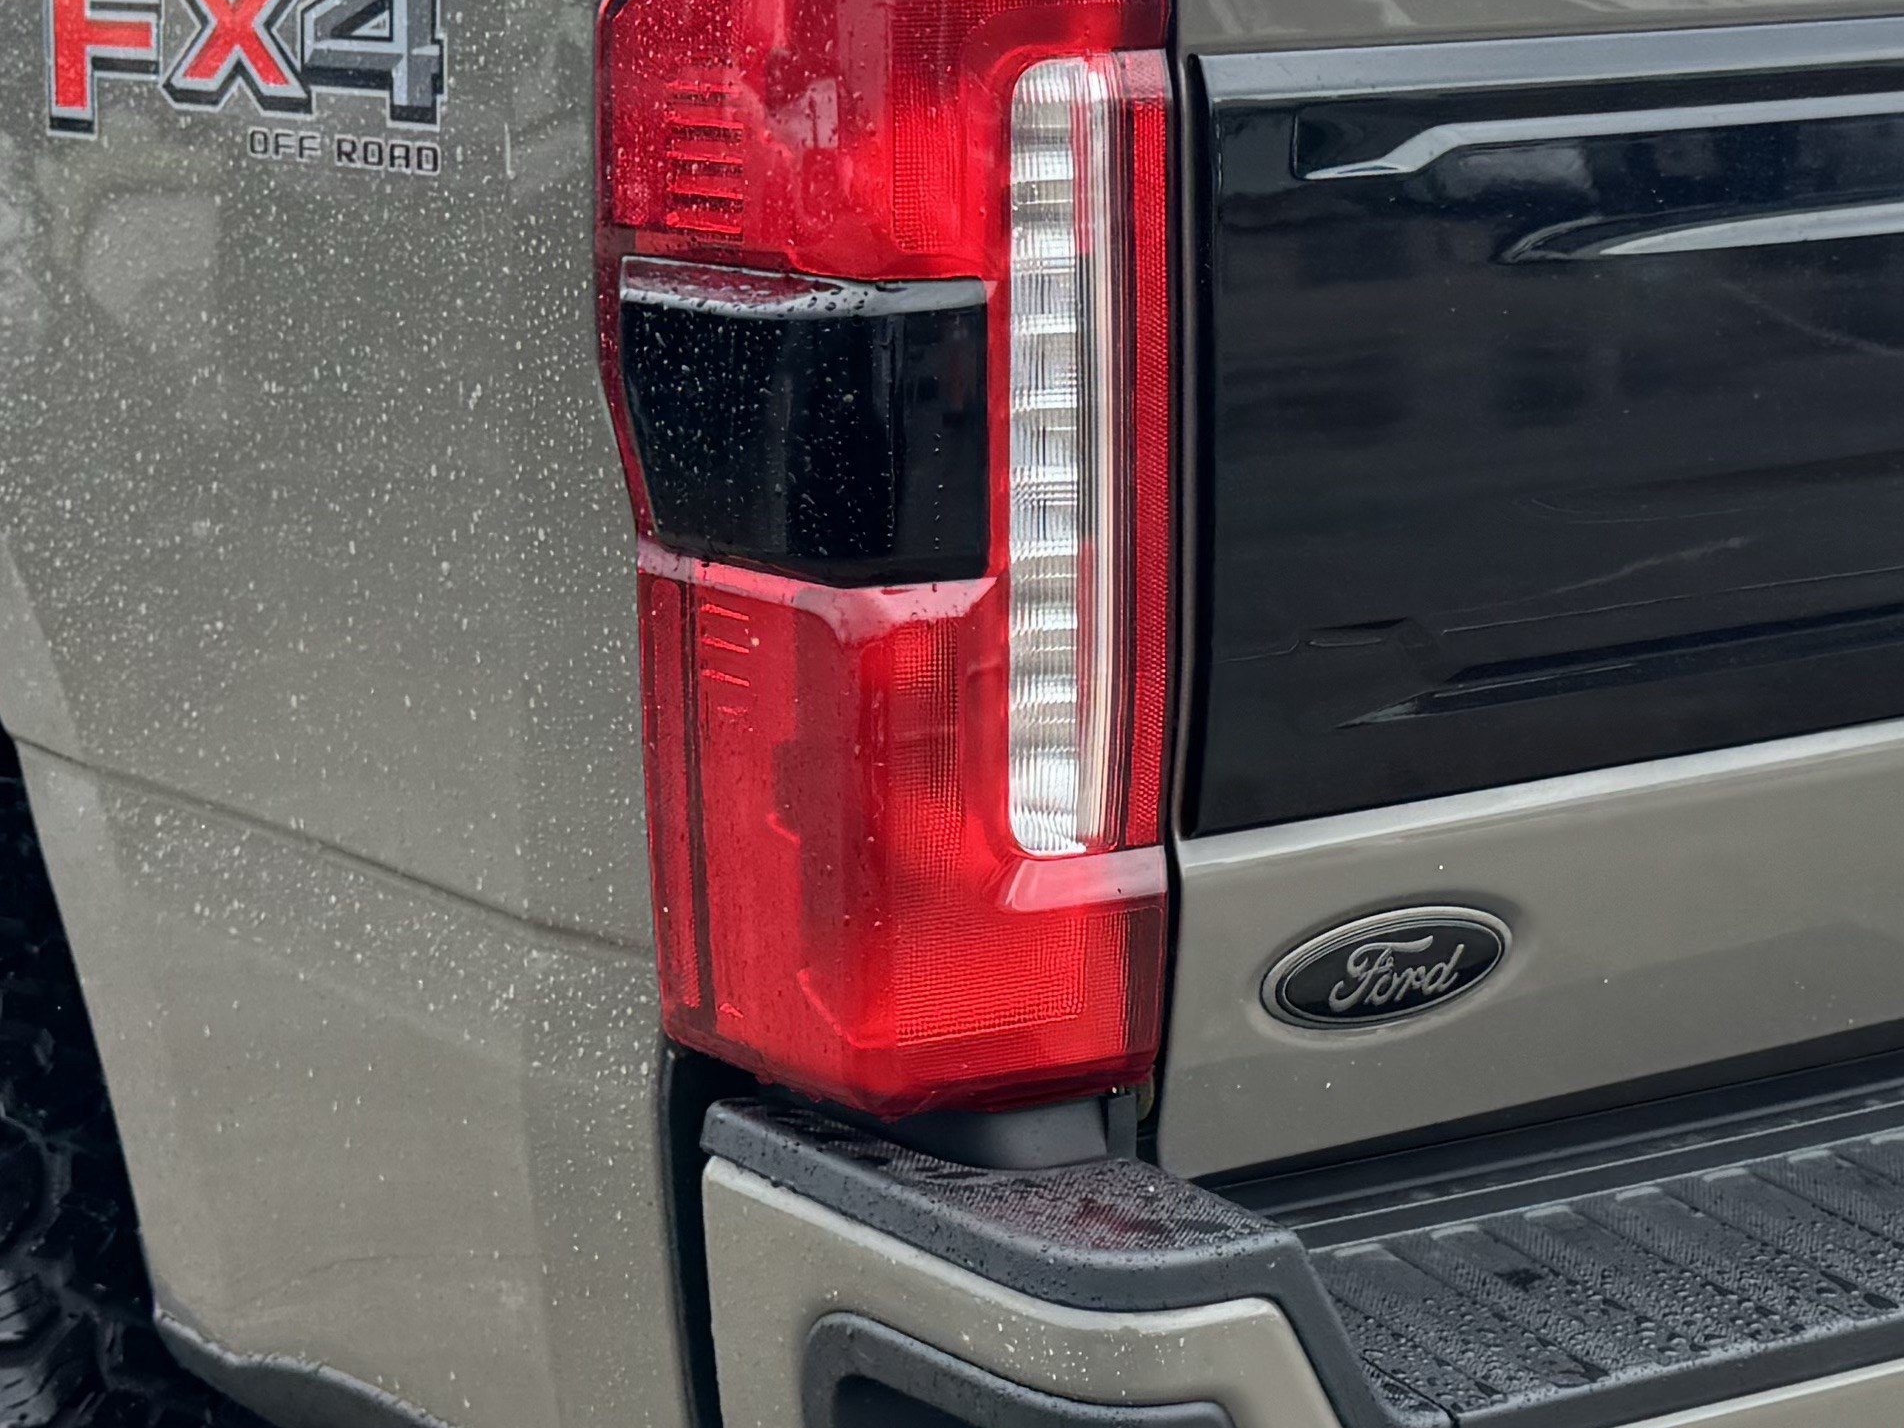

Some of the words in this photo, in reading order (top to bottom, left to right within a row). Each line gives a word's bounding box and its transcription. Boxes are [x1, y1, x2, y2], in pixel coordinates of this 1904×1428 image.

[247, 126, 322, 162] OFF
[334, 133, 441, 176] ROAD
[1327, 934, 1465, 1013] Ford
